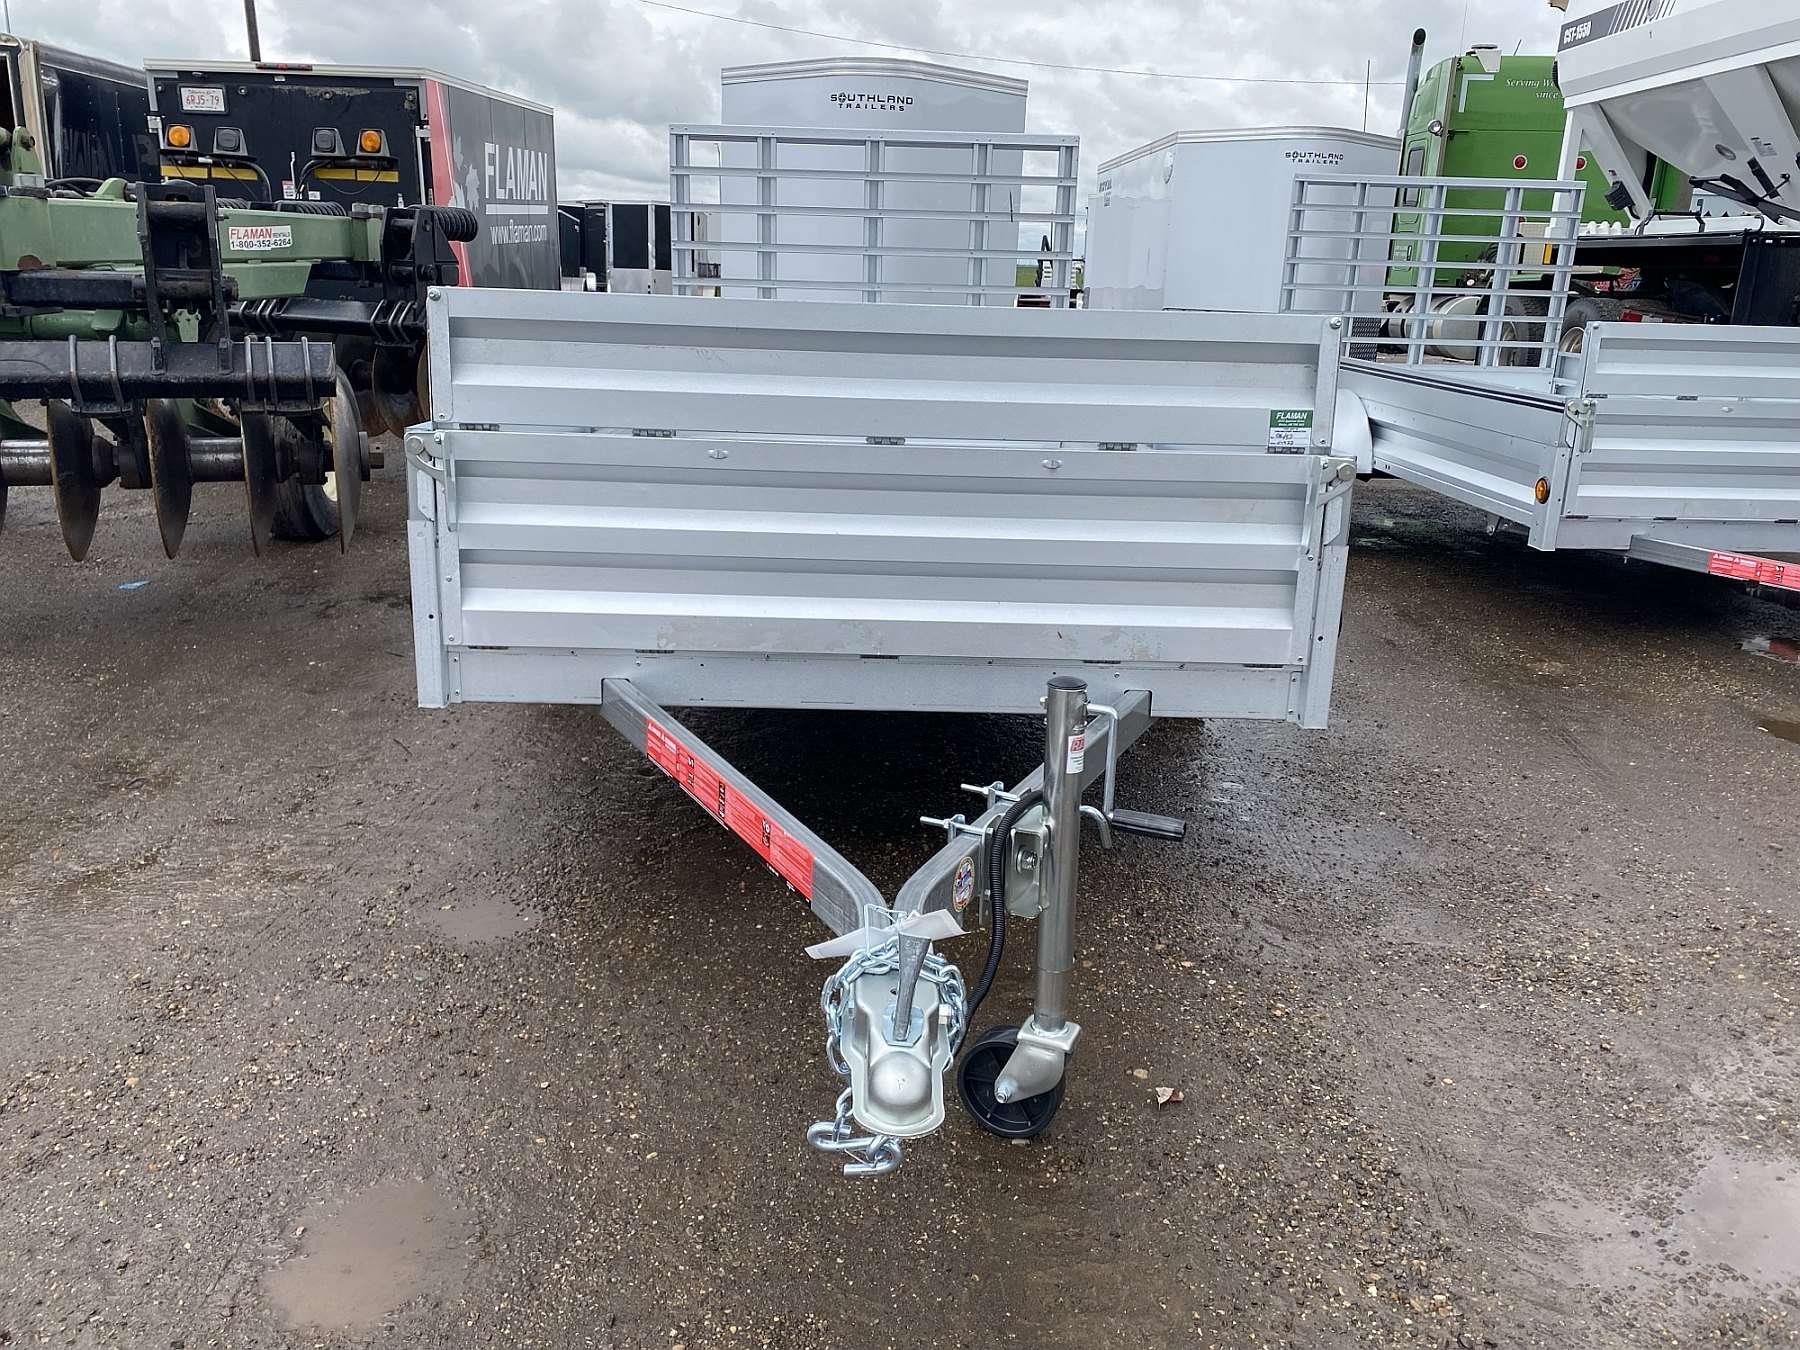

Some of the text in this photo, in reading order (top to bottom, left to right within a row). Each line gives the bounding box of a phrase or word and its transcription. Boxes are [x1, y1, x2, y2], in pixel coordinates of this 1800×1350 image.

[1505, 79, 1555, 88] Serving We
[830, 92, 914, 105] SOUTHLAND
[838, 103, 905, 112] TRAILERS
[1285, 151, 1344, 161] SOUTHLAND
[1292, 158, 1339, 166] TRAILERS
[484, 142, 548, 201] FLAMAN
[230, 228, 273, 240] FLAMAN
[490, 219, 548, 246] www.flaman.com
[1276, 411, 1308, 420] FLAMAN
